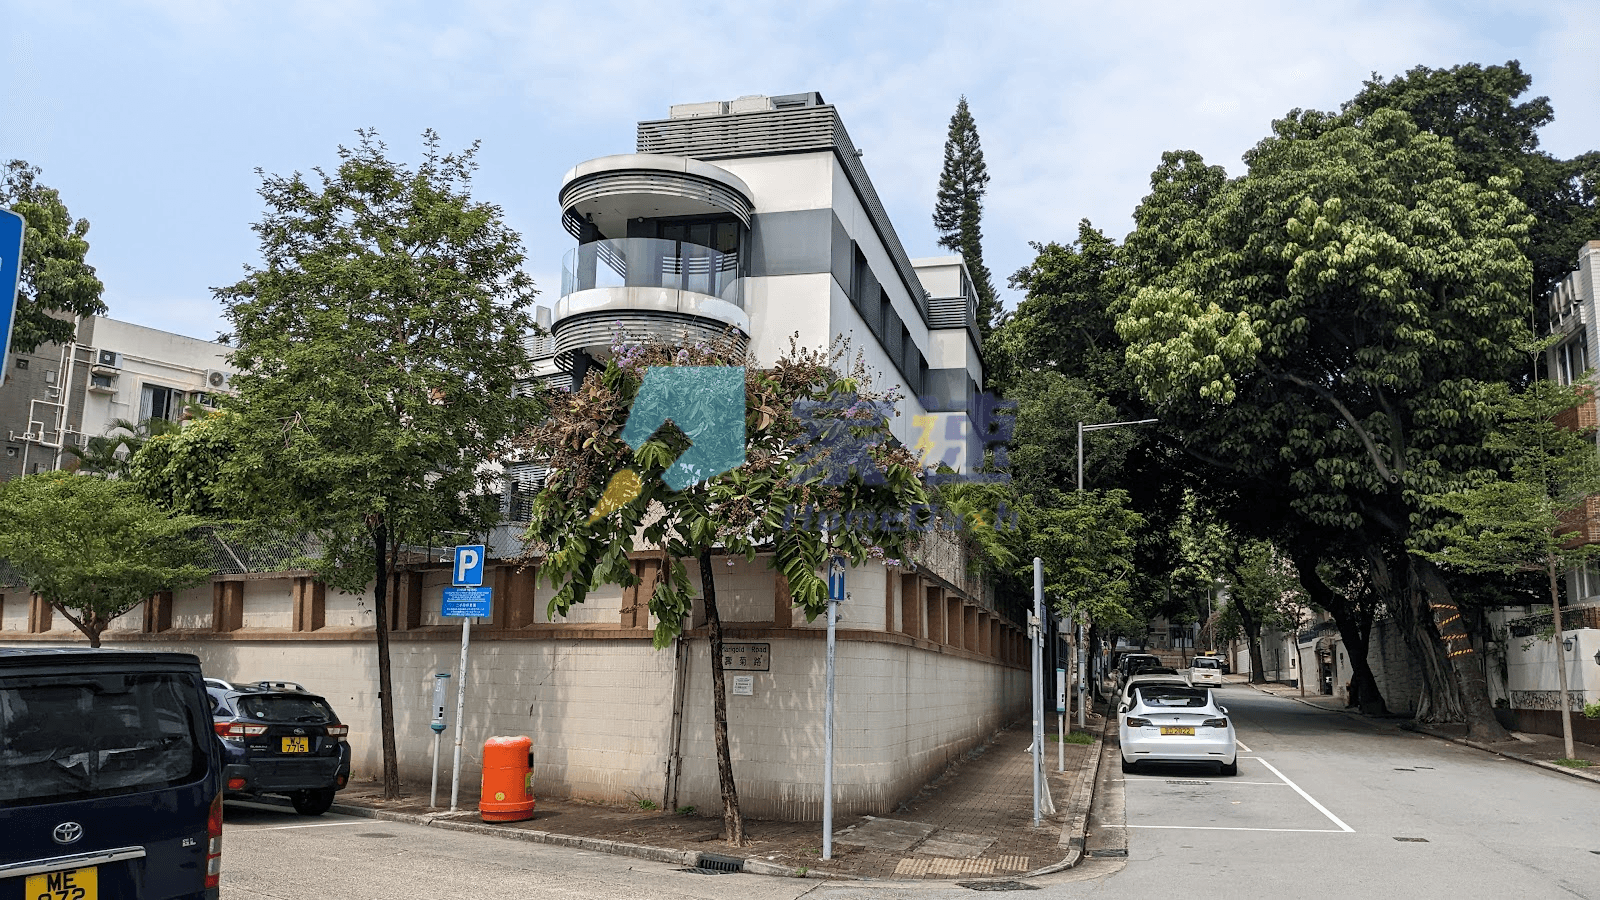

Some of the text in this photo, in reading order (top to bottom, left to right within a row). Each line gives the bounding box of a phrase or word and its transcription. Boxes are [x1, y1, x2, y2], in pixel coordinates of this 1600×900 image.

[458, 549, 479, 582] P
[286, 744, 305, 752] 7715
[47, 870, 77, 893] ME
